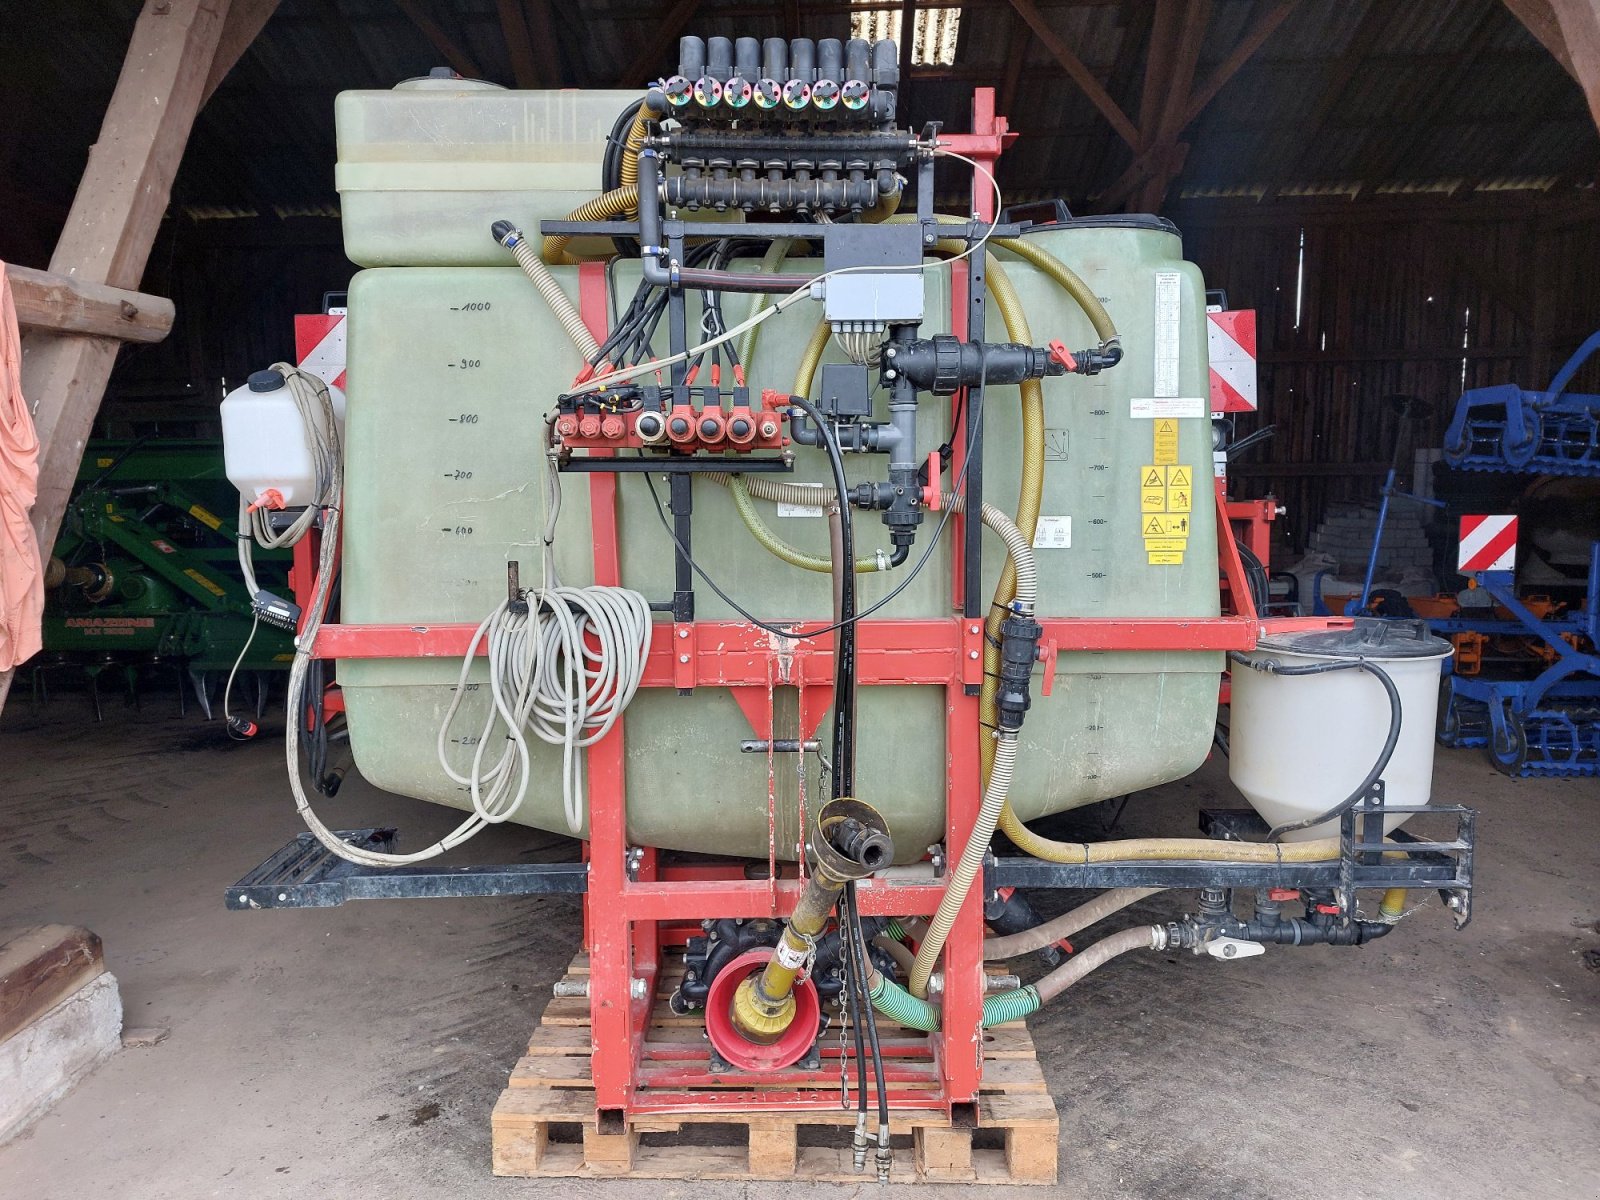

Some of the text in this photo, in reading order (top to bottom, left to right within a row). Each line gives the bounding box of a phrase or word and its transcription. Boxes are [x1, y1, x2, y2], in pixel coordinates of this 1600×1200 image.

[461, 302, 491, 311] 1000
[460, 359, 481, 369] 900
[459, 414, 479, 424] 800
[454, 470, 473, 480] 700
[65, 617, 155, 628] AMAZONE
